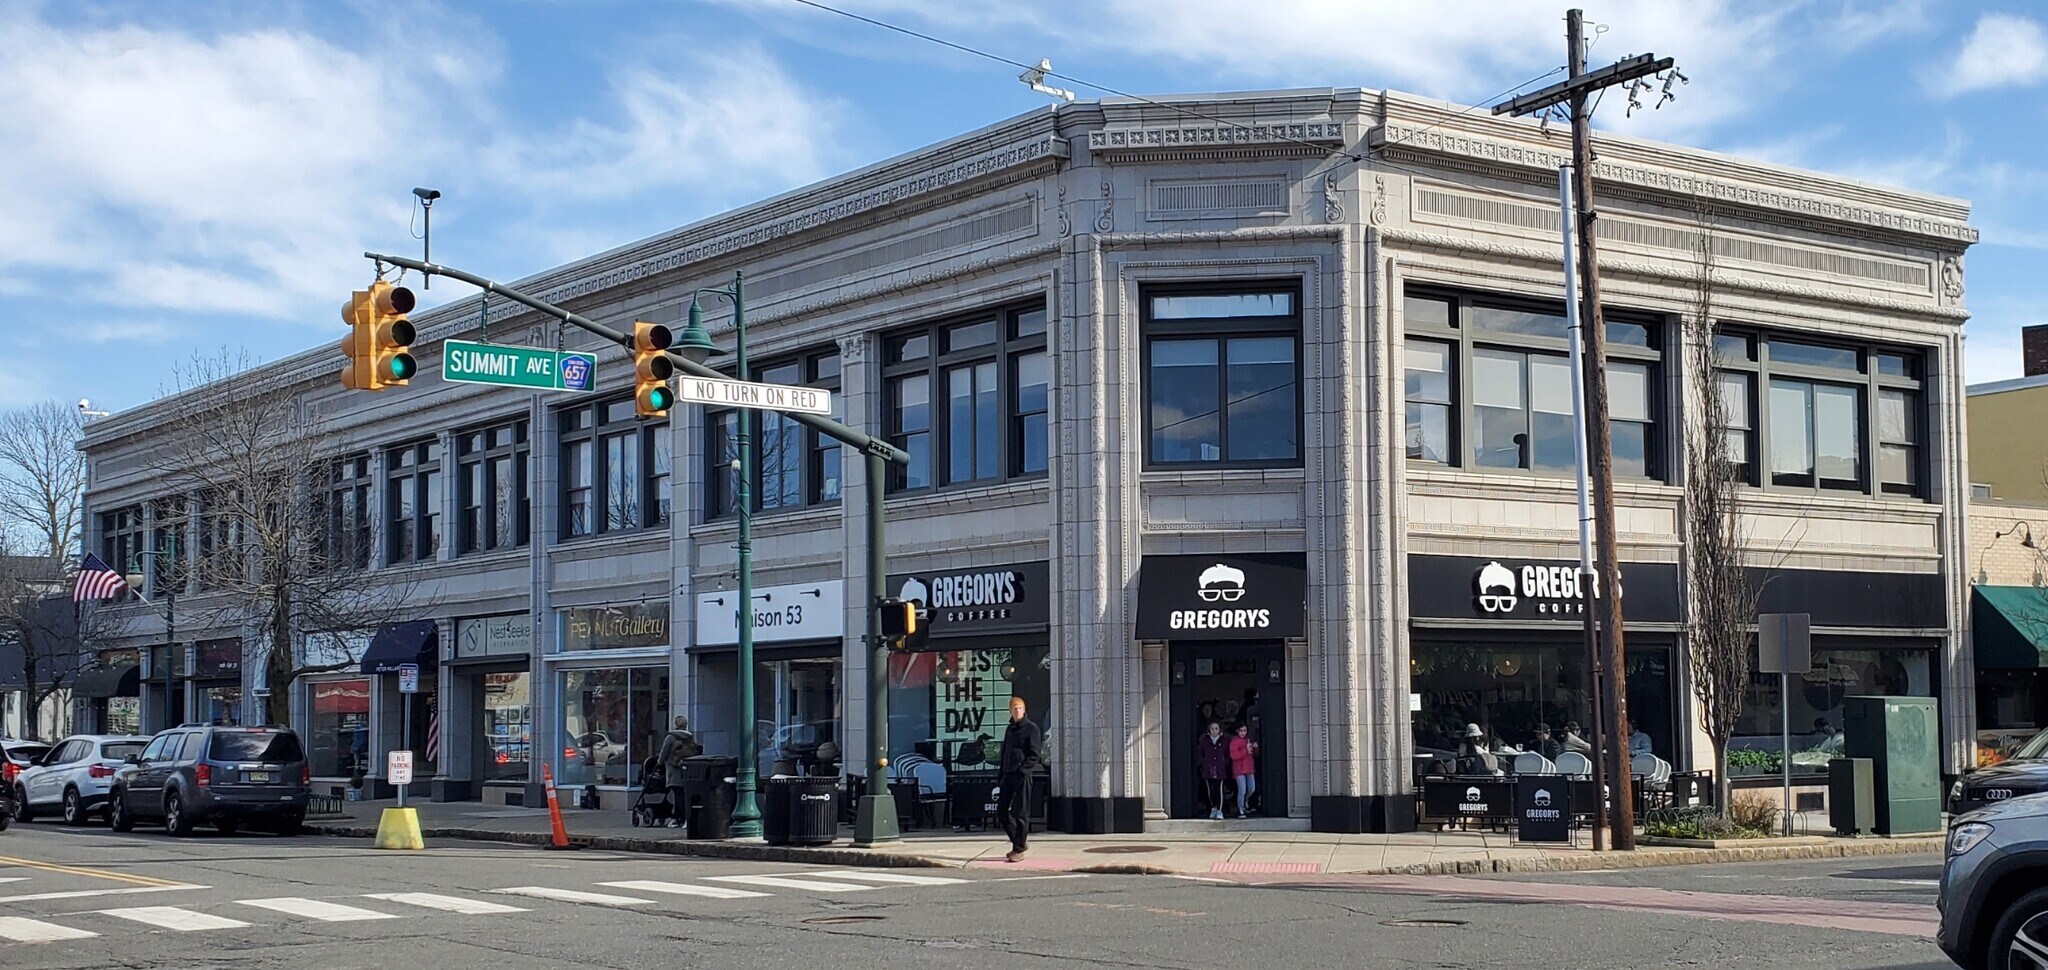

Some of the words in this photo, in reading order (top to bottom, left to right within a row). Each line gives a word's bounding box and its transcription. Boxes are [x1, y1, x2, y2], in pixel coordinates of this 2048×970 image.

[450, 350, 519, 377] SUMMIT
[526, 357, 552, 375] AVE
[565, 365, 587, 380] 657
[696, 381, 715, 399] NO
[723, 384, 759, 403] TURN
[766, 387, 785, 405] ON
[791, 390, 817, 408] RED
[932, 571, 1016, 608] GREGORYS
[1522, 565, 1623, 599] GREGOR
[735, 608, 782, 629] ison
[786, 604, 803, 625] 53
[948, 608, 1006, 622] COFFEE
[1169, 608, 1270, 629] GREGORYS
[1539, 603, 1584, 614] COFF
[506, 623, 531, 639] Seeke
[945, 677, 983, 702] THE
[945, 706, 987, 734] DAY
[1458, 803, 1489, 811] GREGORYS
[1526, 808, 1560, 818] GREGORYS
